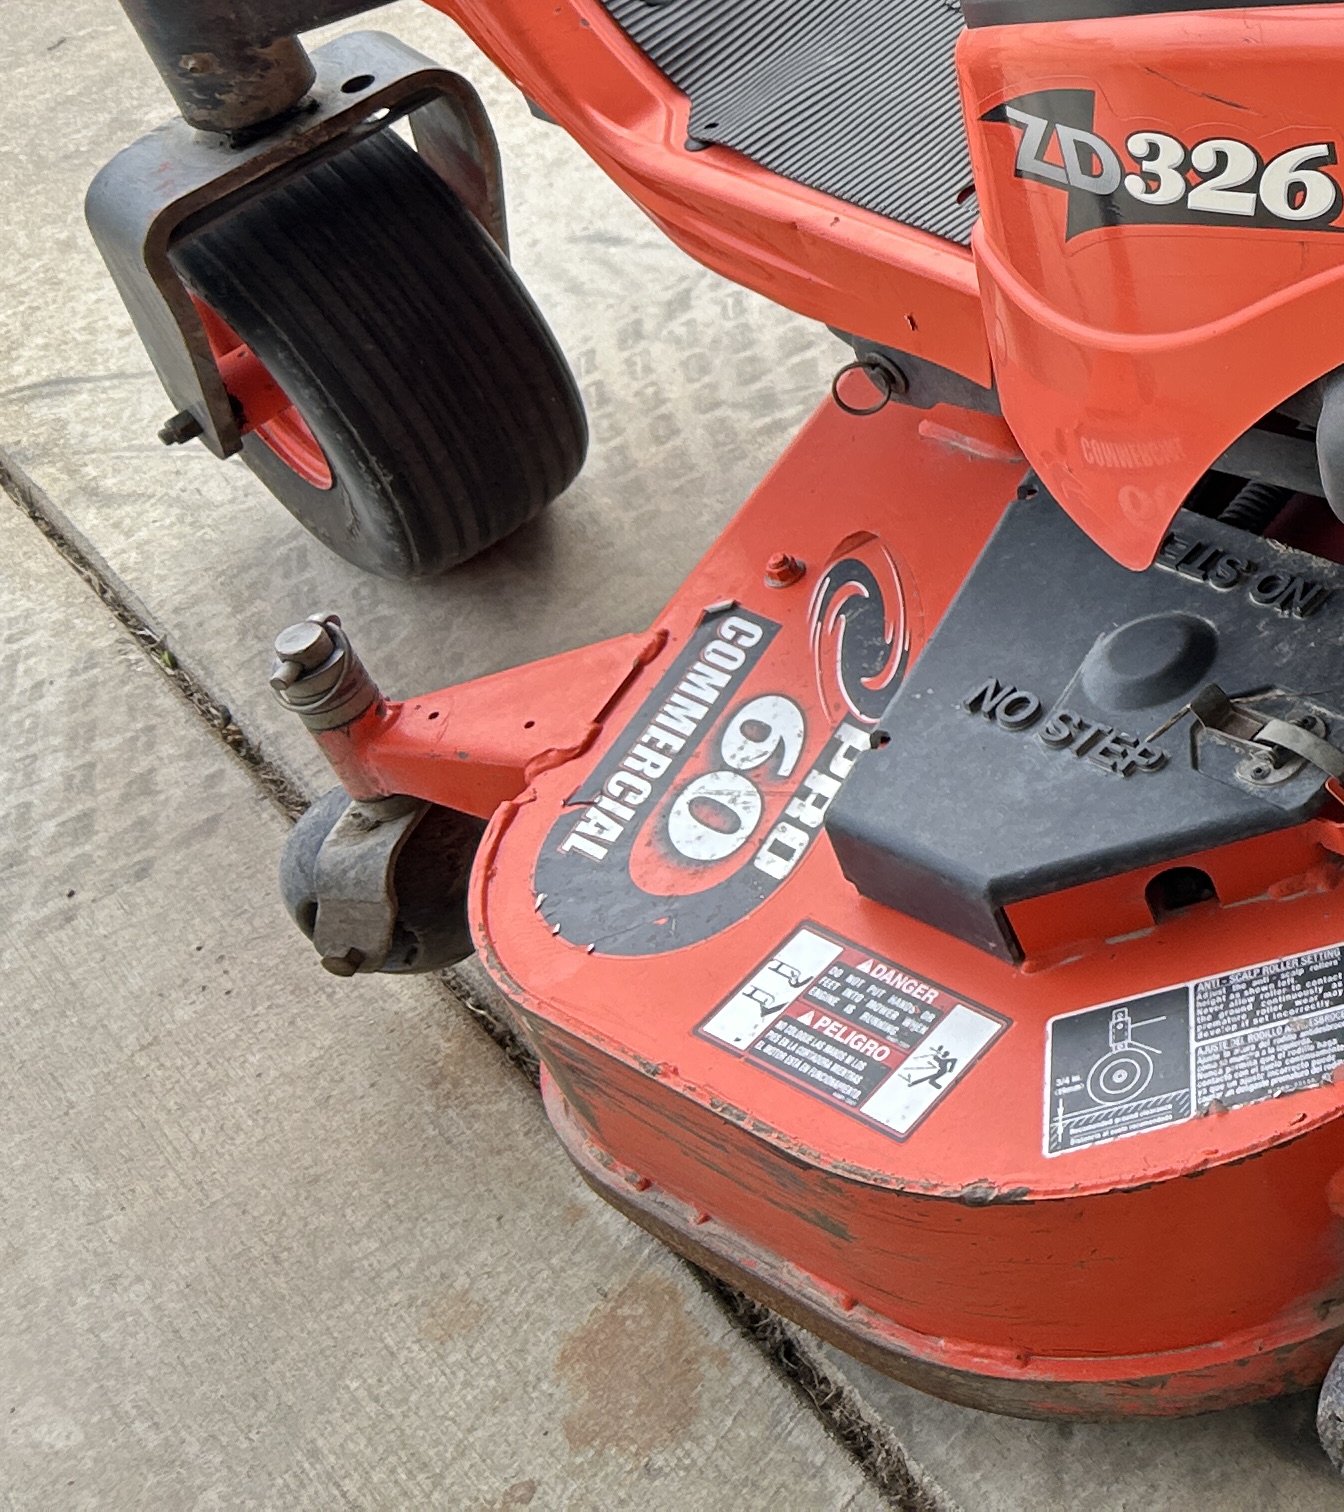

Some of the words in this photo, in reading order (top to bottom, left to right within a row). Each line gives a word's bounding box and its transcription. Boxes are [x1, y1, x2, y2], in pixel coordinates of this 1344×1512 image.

[1004, 104, 1337, 222] ZD326
[1156, 531, 1259, 591] STE
[557, 614, 765, 862] COMMERCIAL
[962, 677, 1043, 733] NO
[1038, 710, 1172, 778] STEP
[667, 693, 807, 862] 60
[868, 962, 941, 1005] DANGER
[1196, 976, 1220, 992] ANTI
[1228, 967, 1260, 984] SCALP
[1261, 957, 1298, 976] ROLLER
[1300, 947, 1341, 966] SETTING
[1196, 986, 1226, 1000] Adjust
[1280, 966, 1304, 980] scalp
[1228, 994, 1255, 1008] allow
[1259, 986, 1287, 1000] roller
[1291, 983, 1301, 991] to
[1305, 972, 1342, 988] contact
[1243, 982, 1274, 996] shown
[807, 985, 842, 1007] ENGINE
[841, 1003, 857, 1015] IS
[817, 975, 842, 992] FEET
[840, 986, 866, 1003] INTO
[863, 998, 900, 1021] MOWER
[899, 1016, 930, 1035] WHEN
[826, 965, 845, 978] DO
[843, 973, 866, 989] NOT
[864, 984, 886, 999] PUT
[918, 1010, 937, 1023] OR
[1196, 1014, 1212, 1024] the
[1218, 1003, 1252, 1019] ground
[1260, 985, 1323, 1008] continuously
[1255, 1003, 1283, 1016] roller
[1294, 994, 1318, 1006] wear
[1322, 988, 1343, 1000] may
[811, 1014, 893, 1063] PELIGRO
